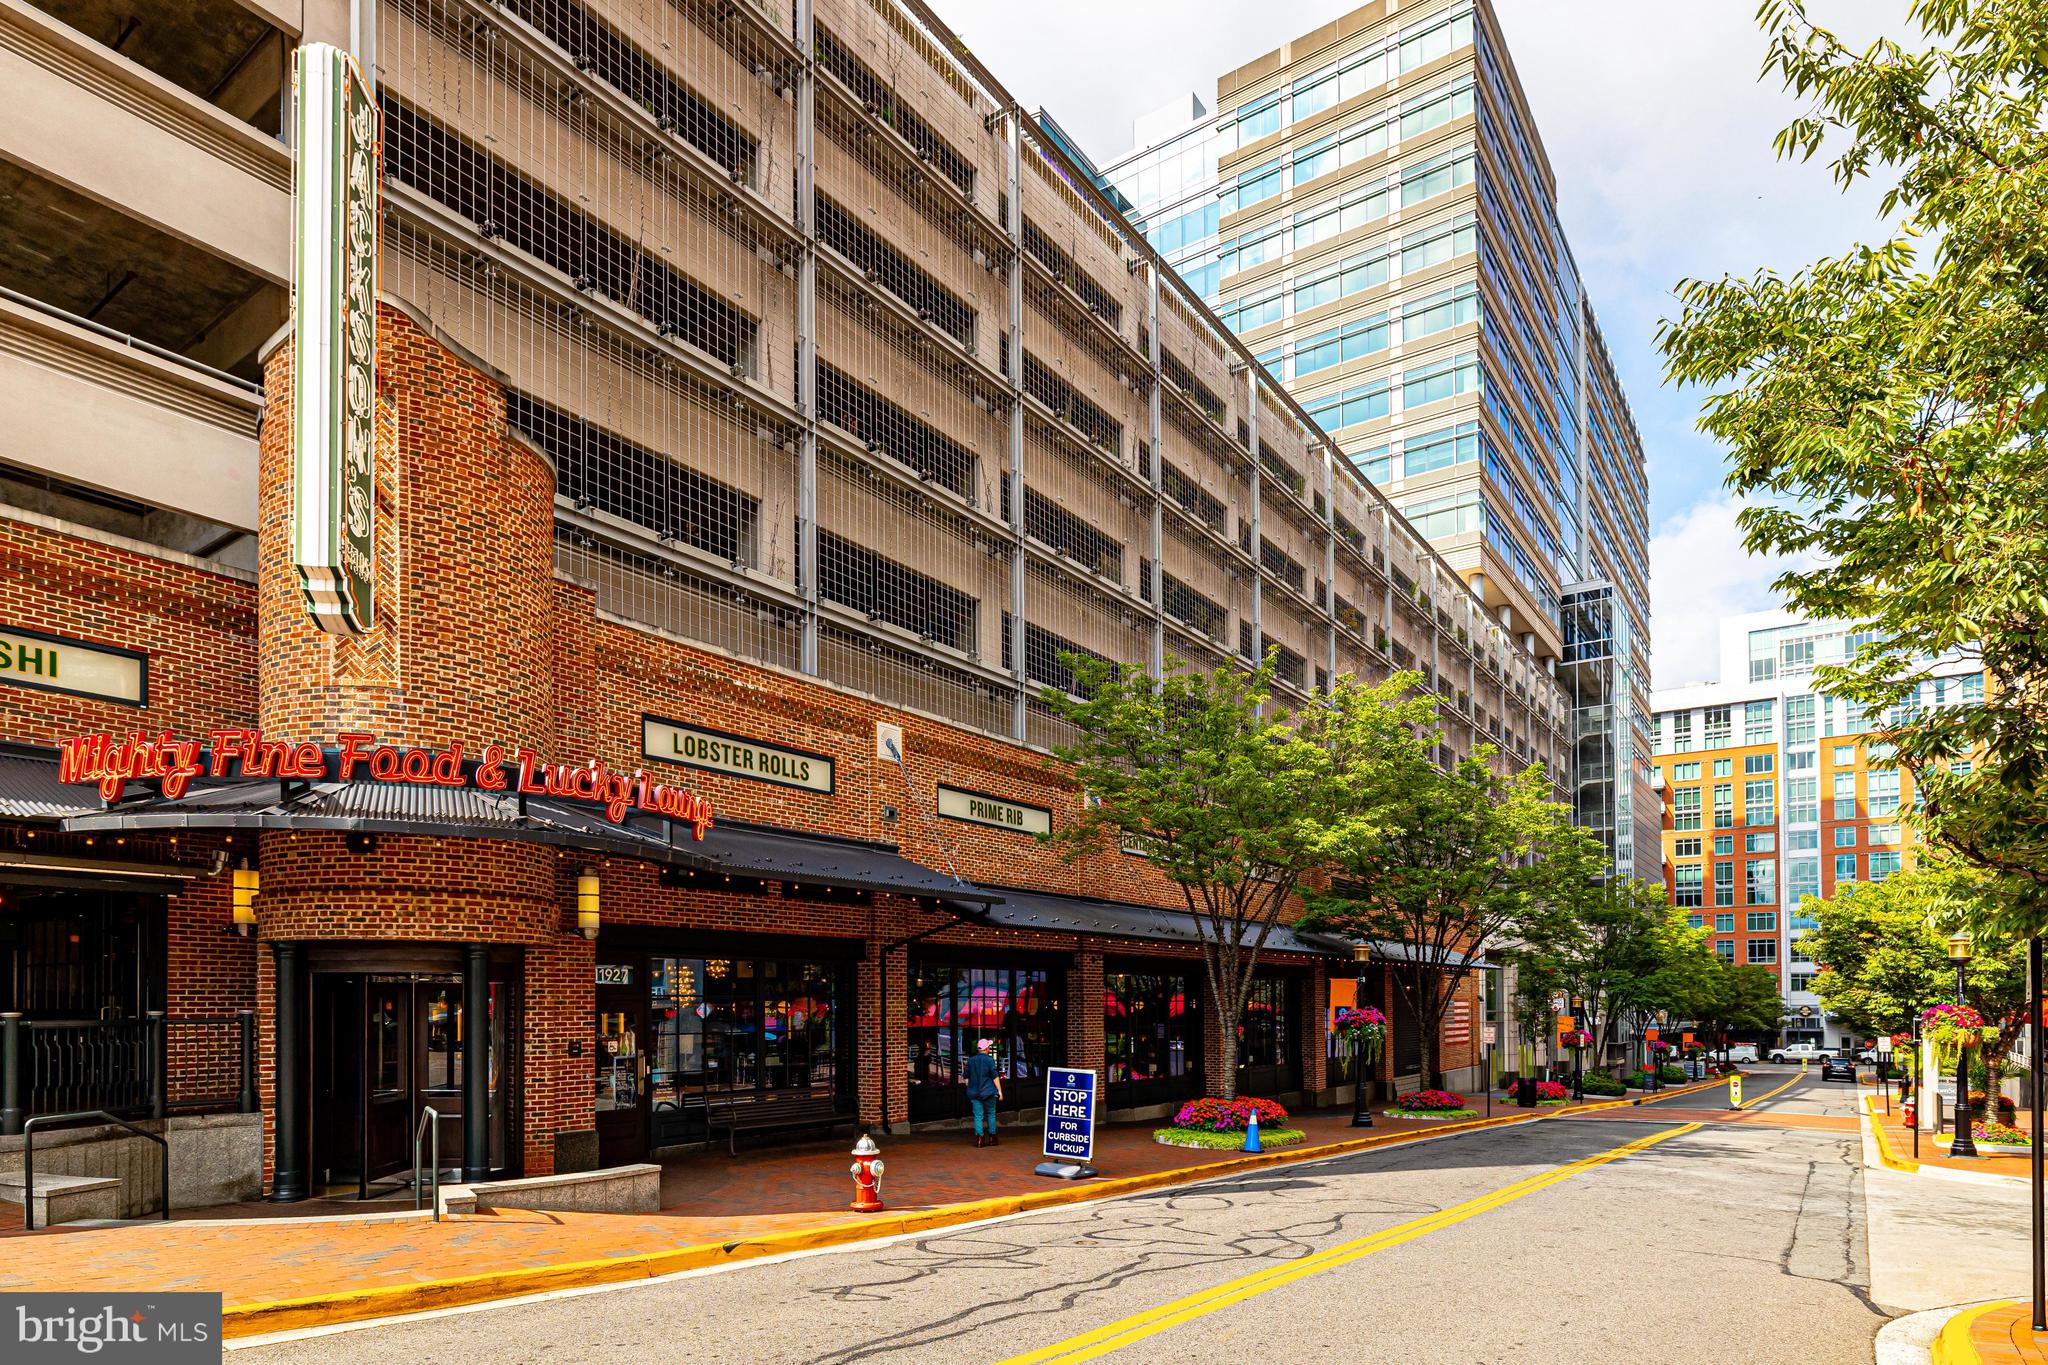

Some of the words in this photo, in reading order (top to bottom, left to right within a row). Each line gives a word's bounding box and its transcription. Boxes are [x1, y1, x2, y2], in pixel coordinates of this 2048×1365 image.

[672, 732, 754, 771] LOBSTER
[759, 752, 810, 782] ROLLS
[58, 729, 204, 802] Mighty
[209, 728, 327, 779] Fine
[337, 732, 467, 786] Food
[475, 744, 508, 791] &
[514, 747, 634, 824] Lucky
[635, 768, 714, 842] Lounge
[969, 799, 1004, 822] PRIME
[1006, 808, 1024, 826] RIB
[1053, 1089, 1088, 1103] STOP
[1052, 1103, 1087, 1118] HERE
[1060, 1121, 1078, 1131] FOR
[1047, 1131, 1090, 1144] CURBSIDE
[1053, 1142, 1085, 1154] PICKUP
